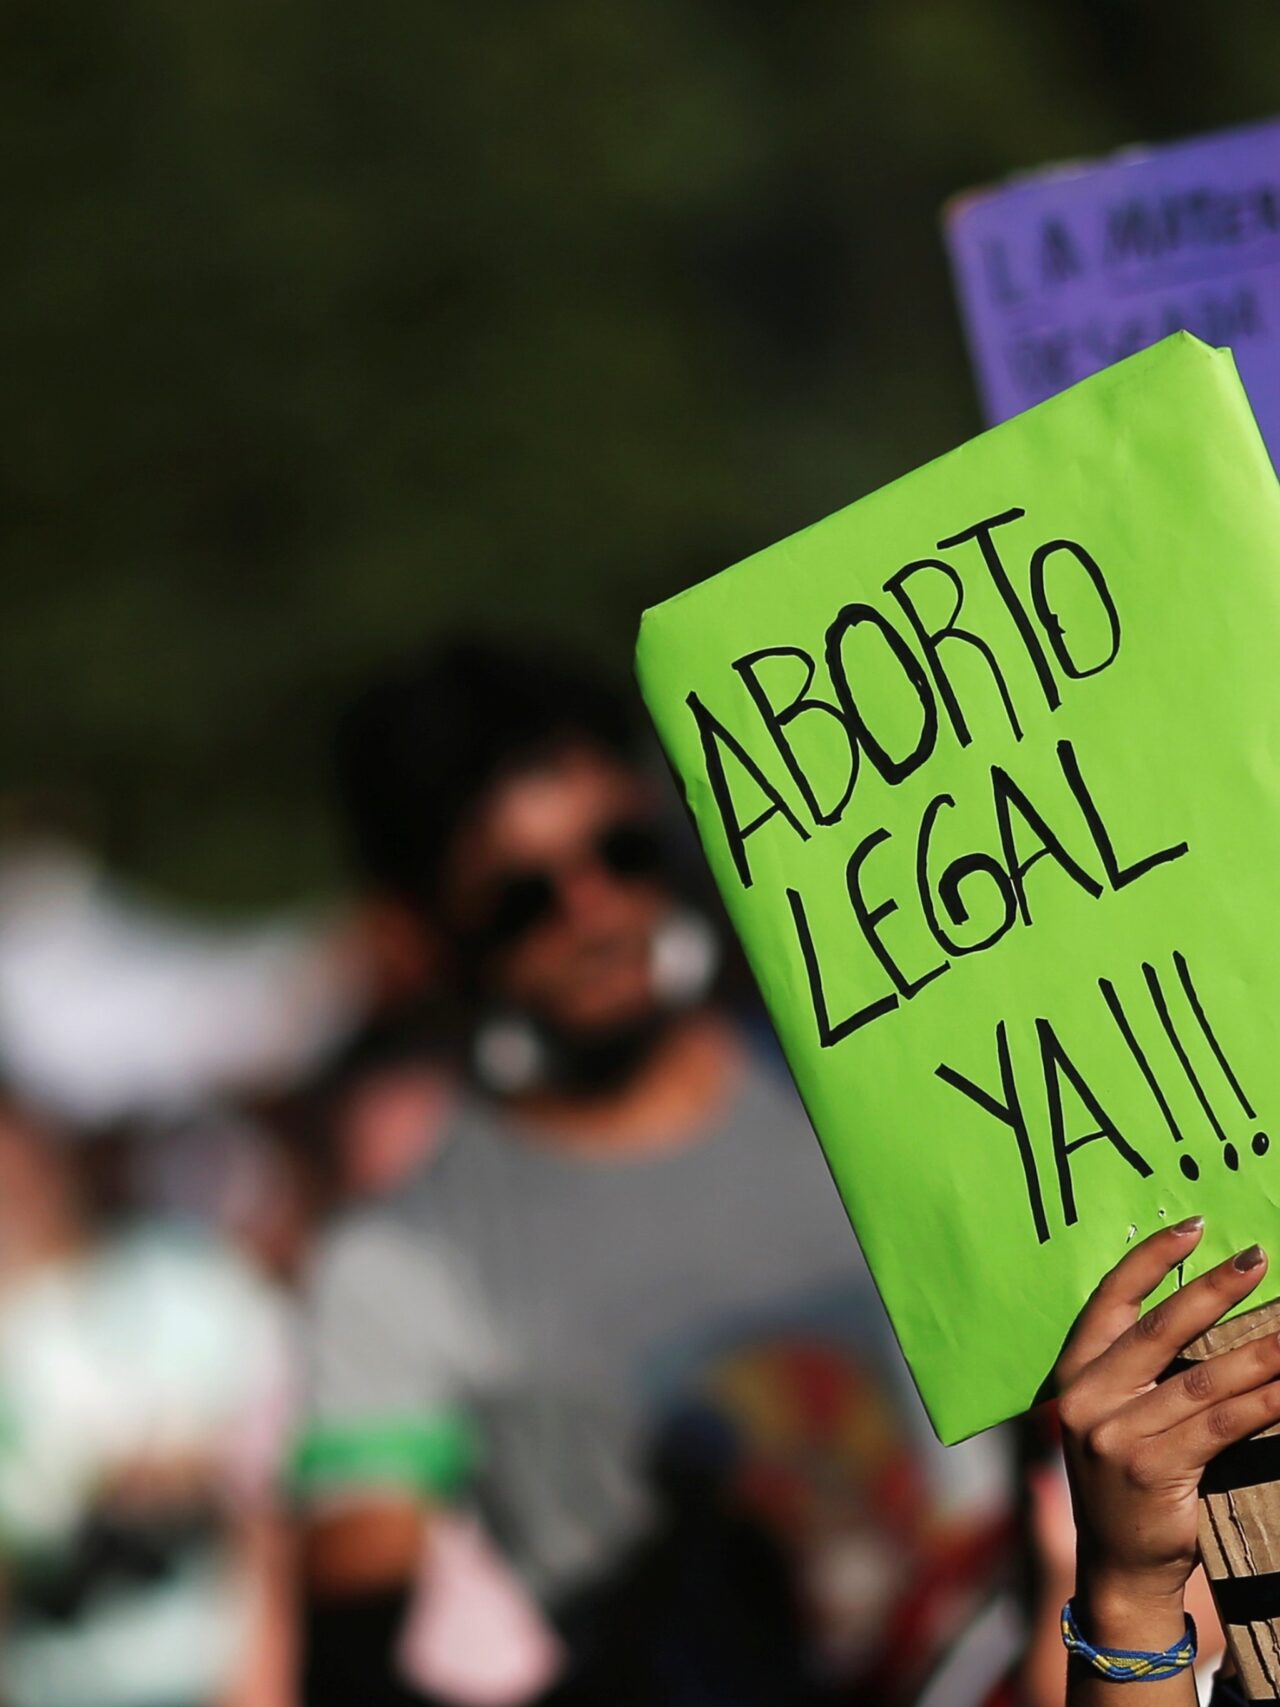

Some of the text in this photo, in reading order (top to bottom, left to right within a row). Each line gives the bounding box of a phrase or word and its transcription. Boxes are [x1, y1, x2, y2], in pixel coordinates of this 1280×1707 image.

[981, 209, 1084, 309] LA
[685, 507, 1122, 888] ABORTO
[786, 740, 1189, 1048] LEGAL
[934, 951, 1270, 1243] YA!!!
